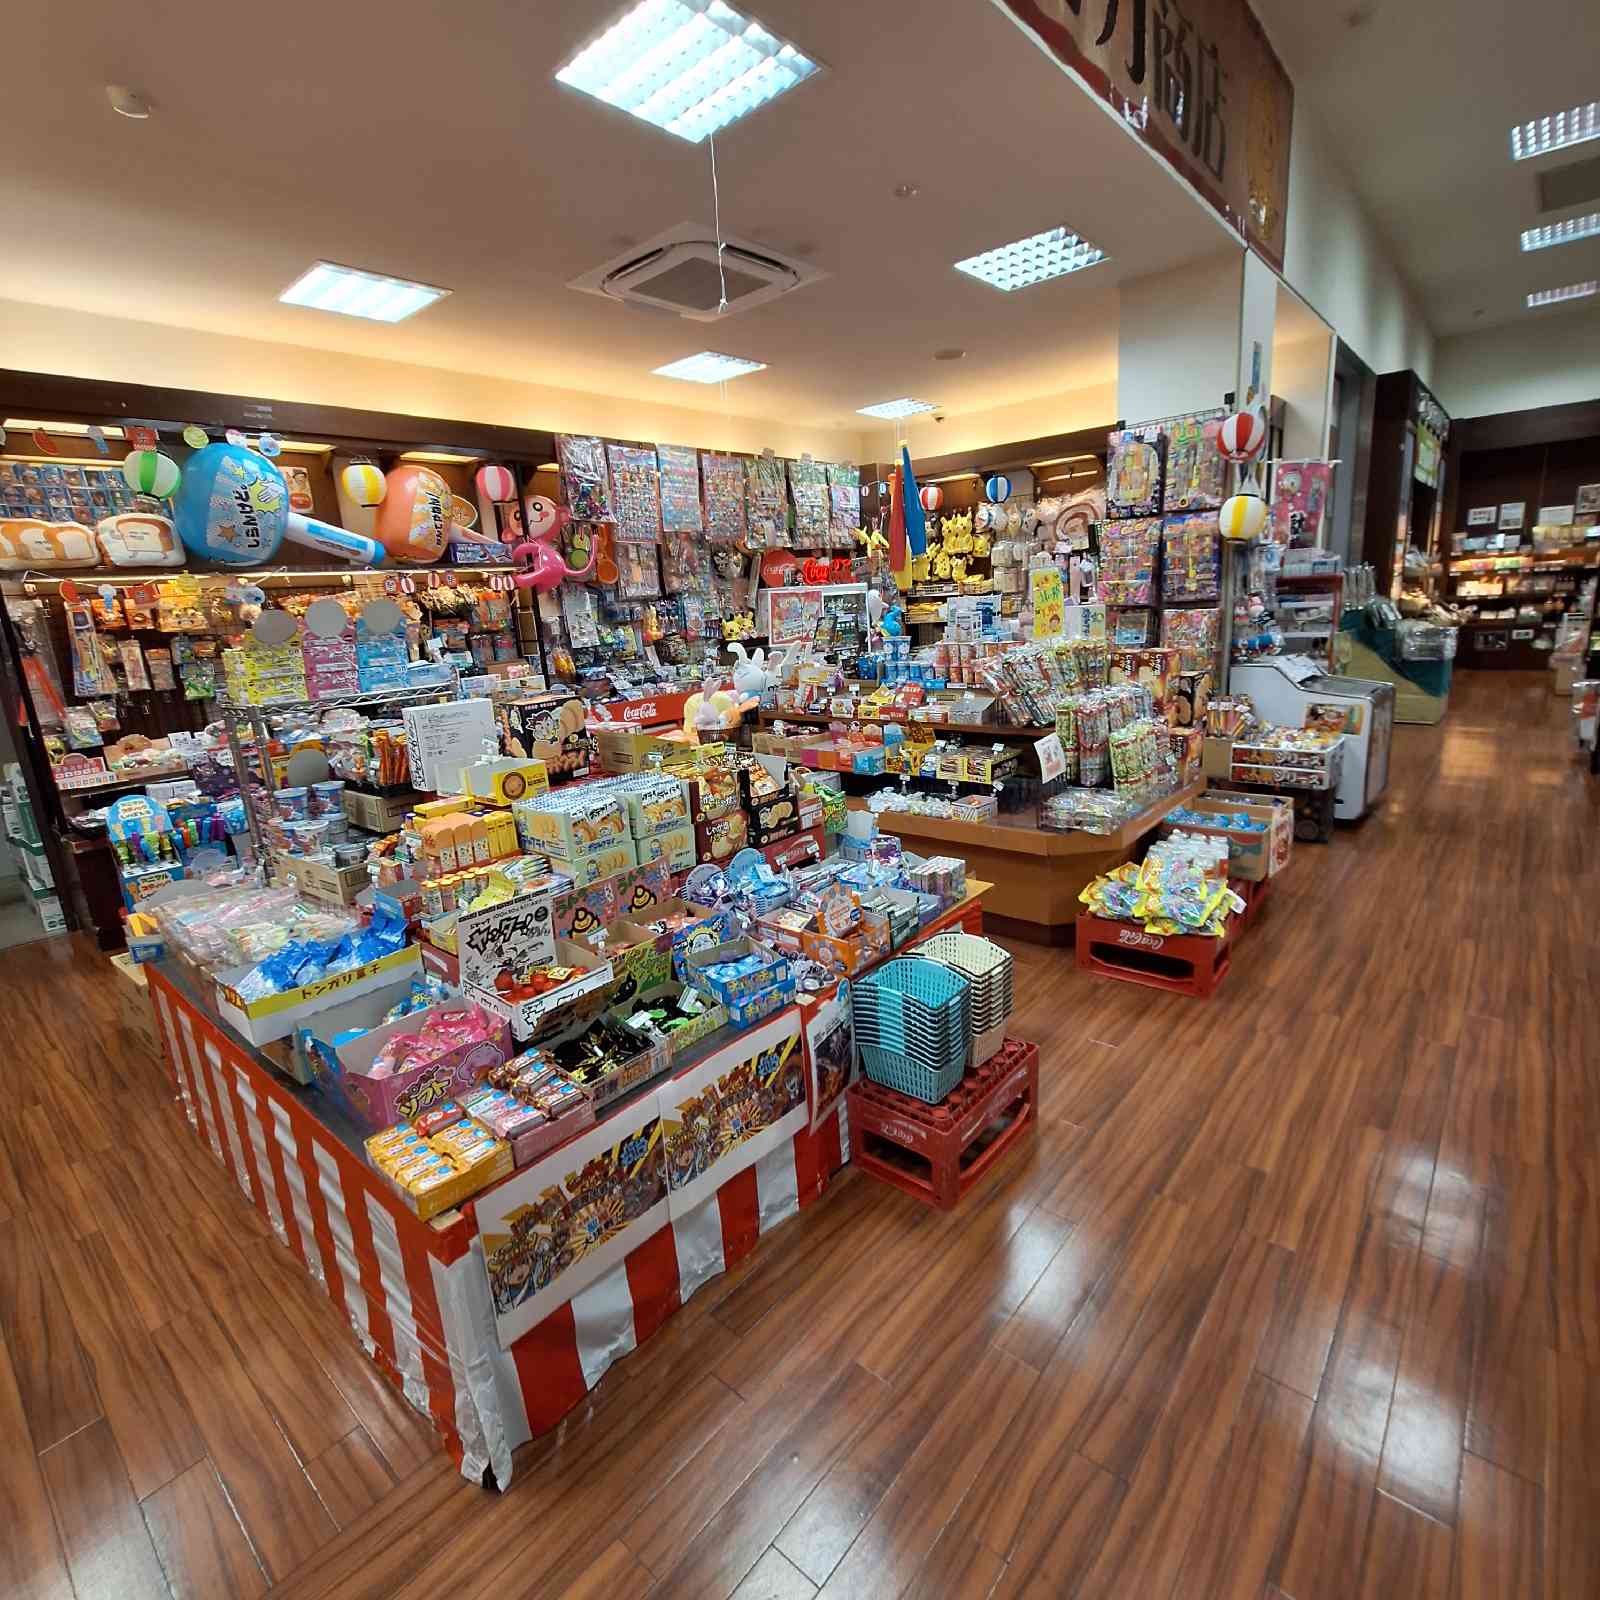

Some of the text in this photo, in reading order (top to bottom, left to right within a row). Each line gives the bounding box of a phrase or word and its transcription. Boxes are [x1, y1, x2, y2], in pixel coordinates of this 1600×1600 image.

[300, 963, 382, 1000] トンガリ菓子
